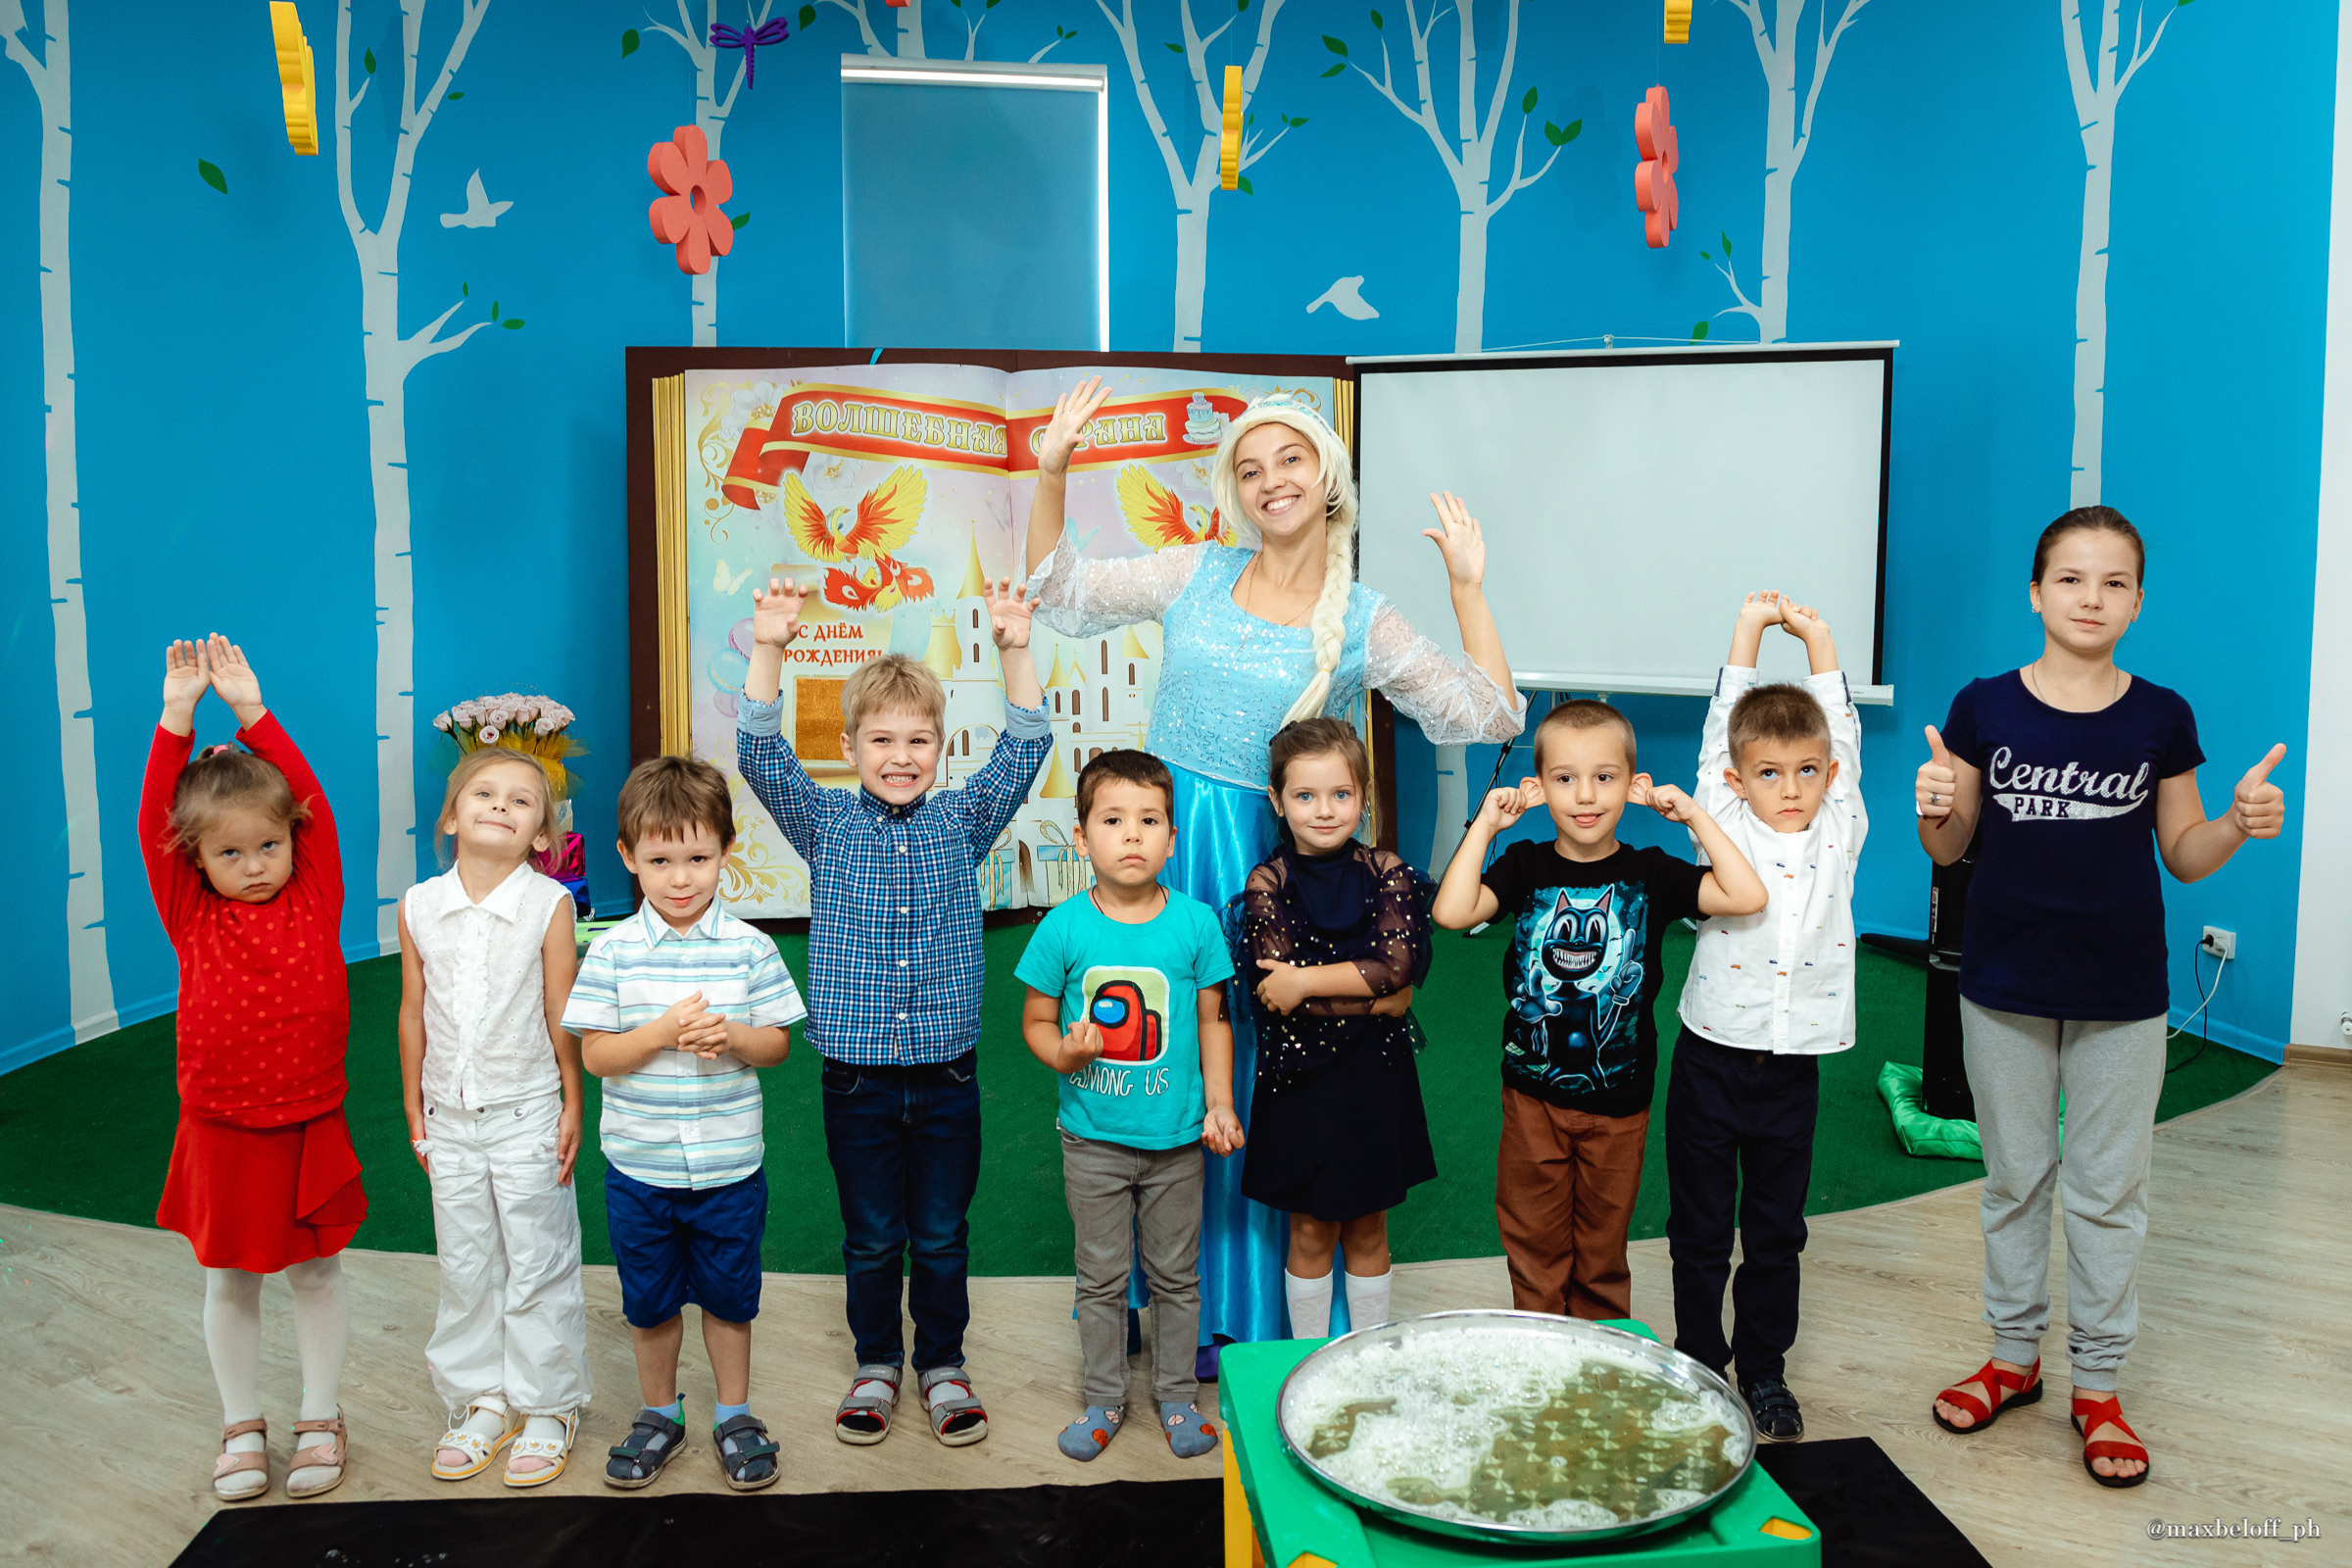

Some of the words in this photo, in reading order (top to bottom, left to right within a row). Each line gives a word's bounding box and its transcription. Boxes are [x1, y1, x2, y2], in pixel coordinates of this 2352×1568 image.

[792, 401, 1007, 457] ВОЛШЕБНАЯ
[798, 624, 808, 639] С
[812, 622, 864, 643] ДНЁМ
[1989, 746, 2150, 801] Central
[2013, 796, 2070, 818] PARK
[1145, 1067, 1170, 1096] US
